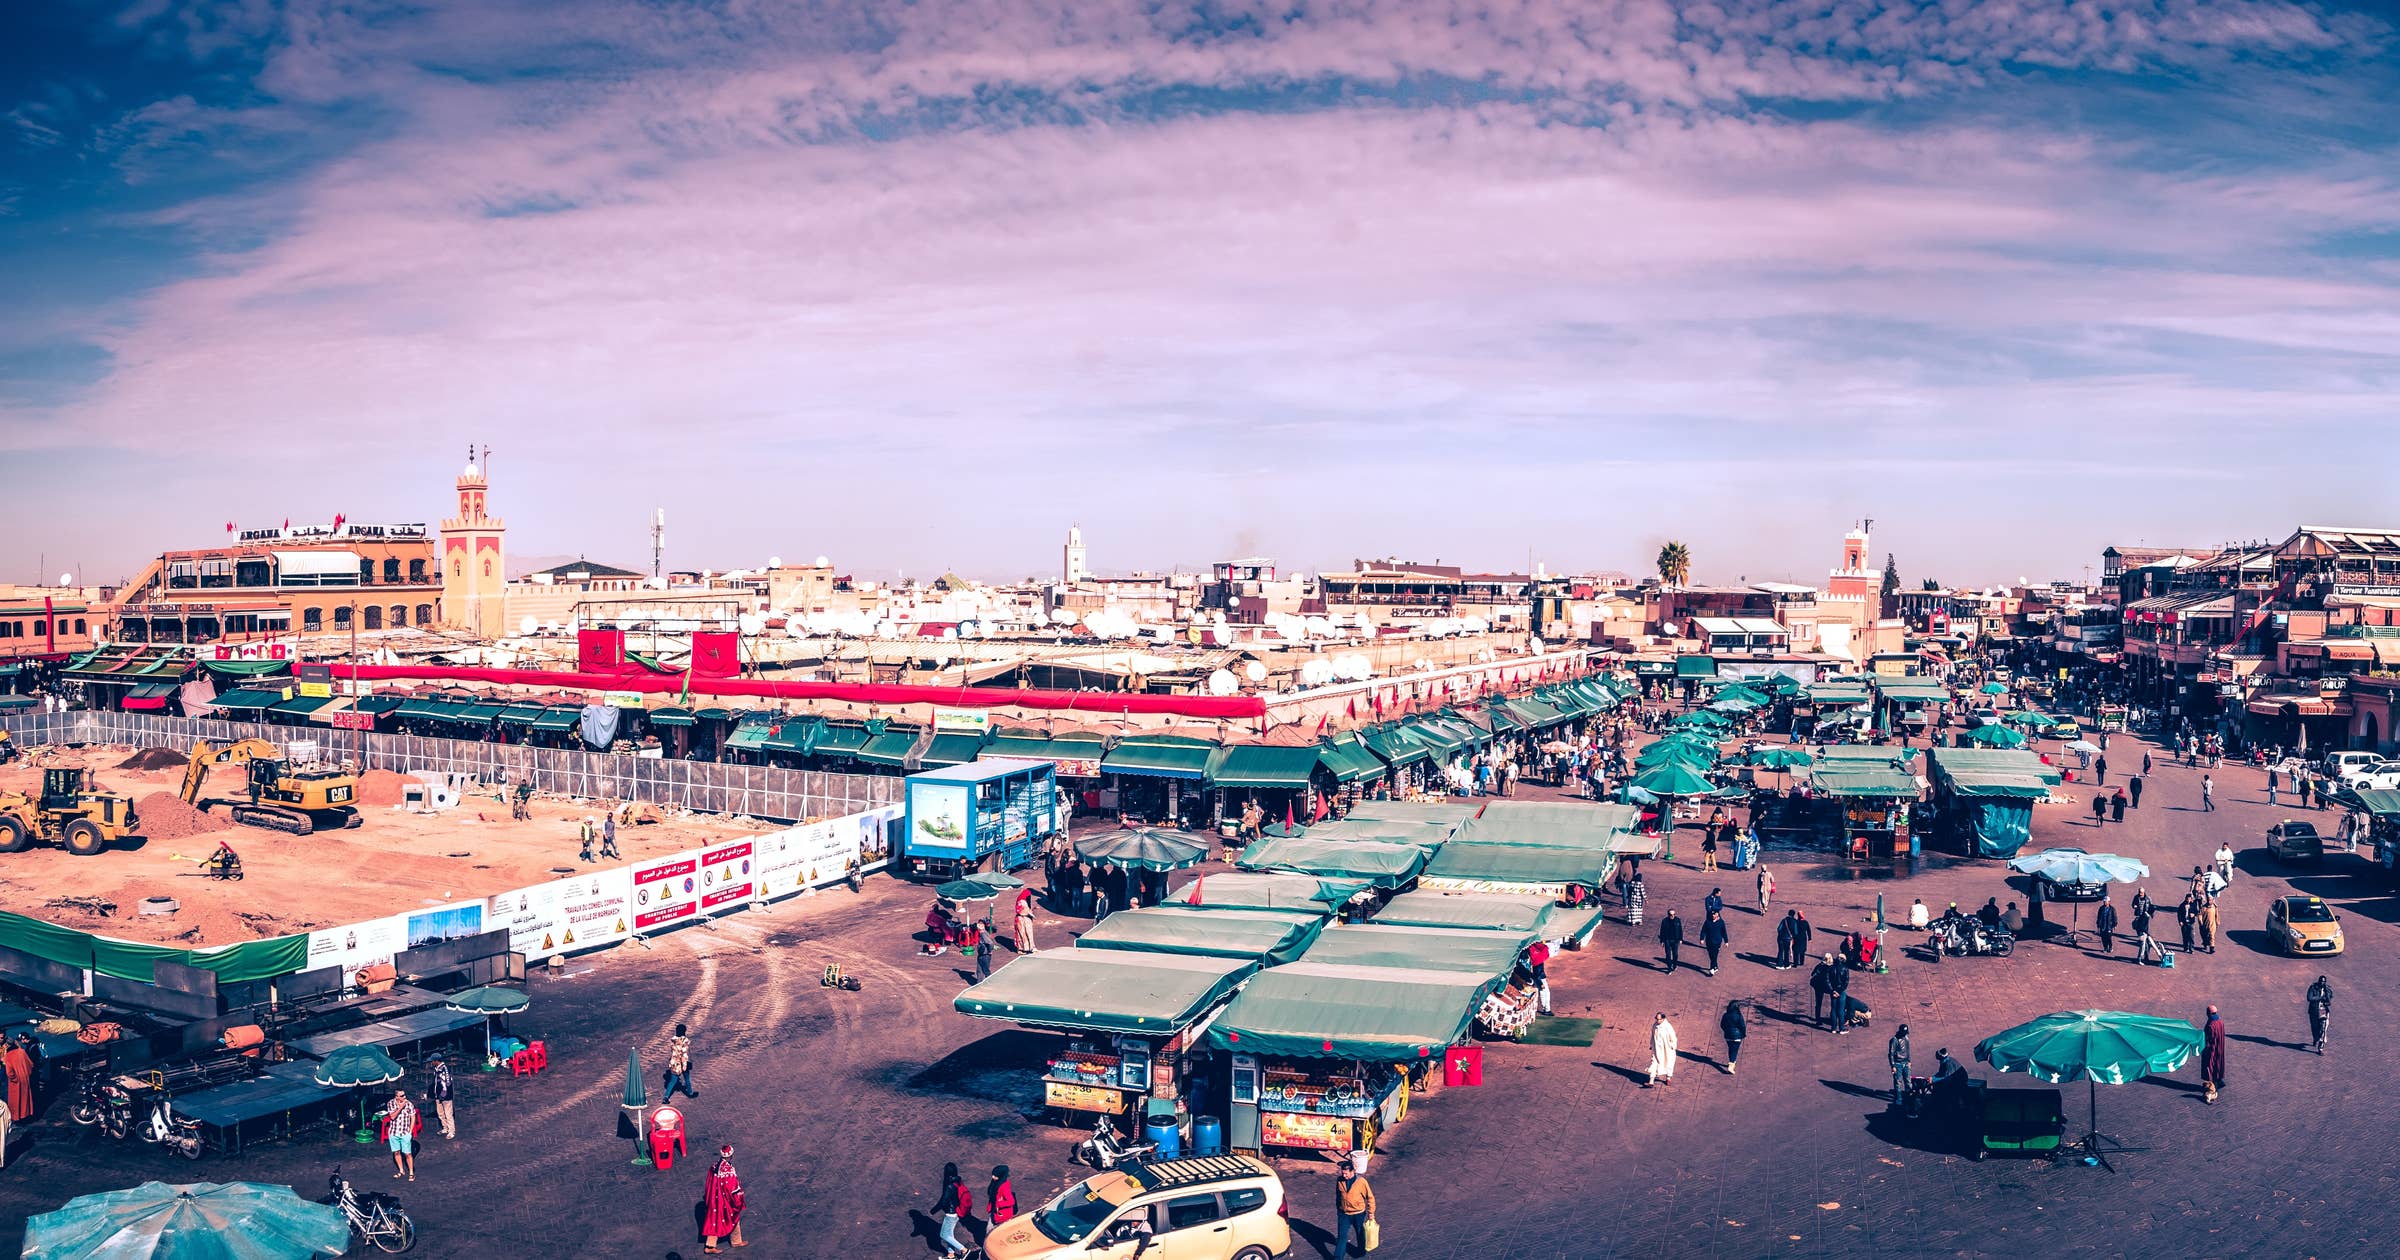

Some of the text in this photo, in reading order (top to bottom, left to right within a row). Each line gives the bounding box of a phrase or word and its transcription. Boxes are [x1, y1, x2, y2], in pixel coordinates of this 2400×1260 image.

[240, 529, 280, 540] ARGANA
[349, 526, 385, 537] ARGANA
[2322, 680, 2347, 689] AQUA
[331, 787, 348, 801] CAT
